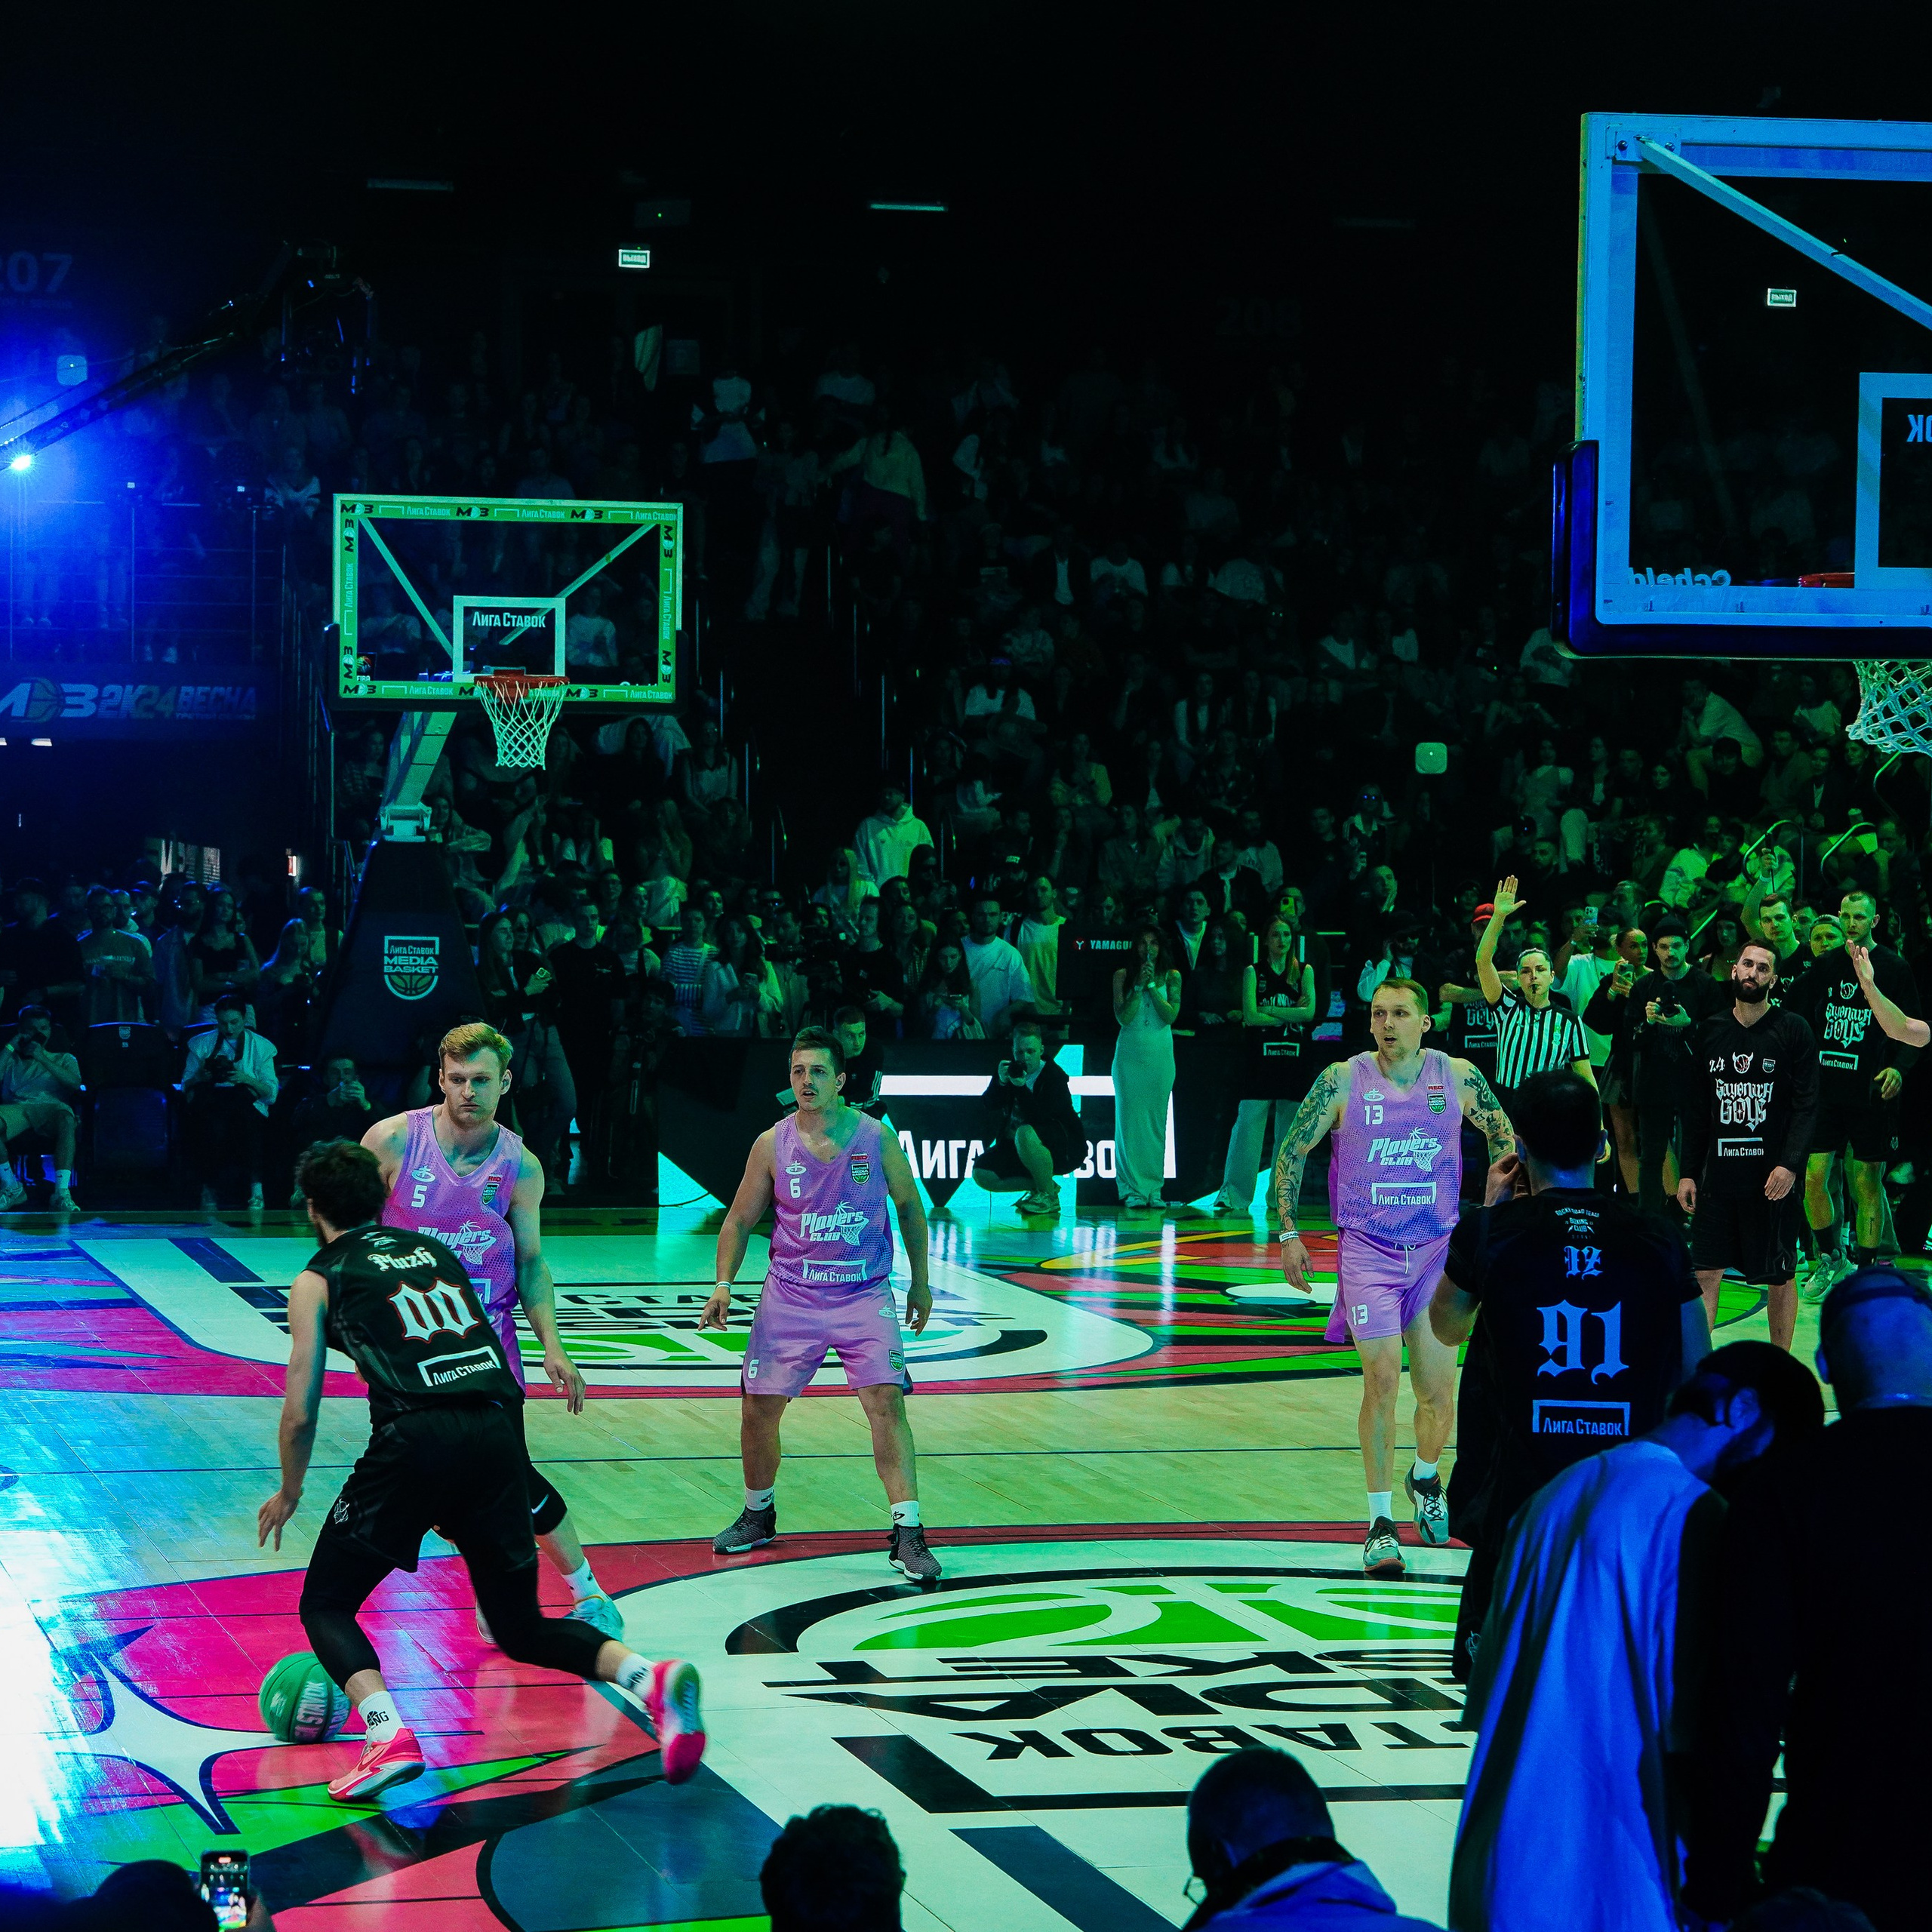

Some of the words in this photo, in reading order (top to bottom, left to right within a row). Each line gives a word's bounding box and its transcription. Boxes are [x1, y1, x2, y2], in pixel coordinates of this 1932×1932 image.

[0, 251, 72, 293] 07
[98, 685, 177, 718] 2K24
[177, 685, 256, 715] ВЕСНА
[383, 955, 438, 965] MEDIA
[383, 965, 439, 974] BASKET
[1364, 1104, 1384, 1125] 13
[1367, 1137, 1438, 1163] Players
[1380, 1157, 1414, 1166] CLUB
[411, 1184, 428, 1208] 5
[789, 1178, 801, 1198] 6
[800, 1211, 864, 1238] Players
[809, 1232, 841, 1241] CLUB
[1351, 1304, 1368, 1326] 13
[1536, 1299, 1629, 1385] 91
[747, 1358, 760, 1380] 6
[949, 1721, 1477, 1761] ТАВОК
